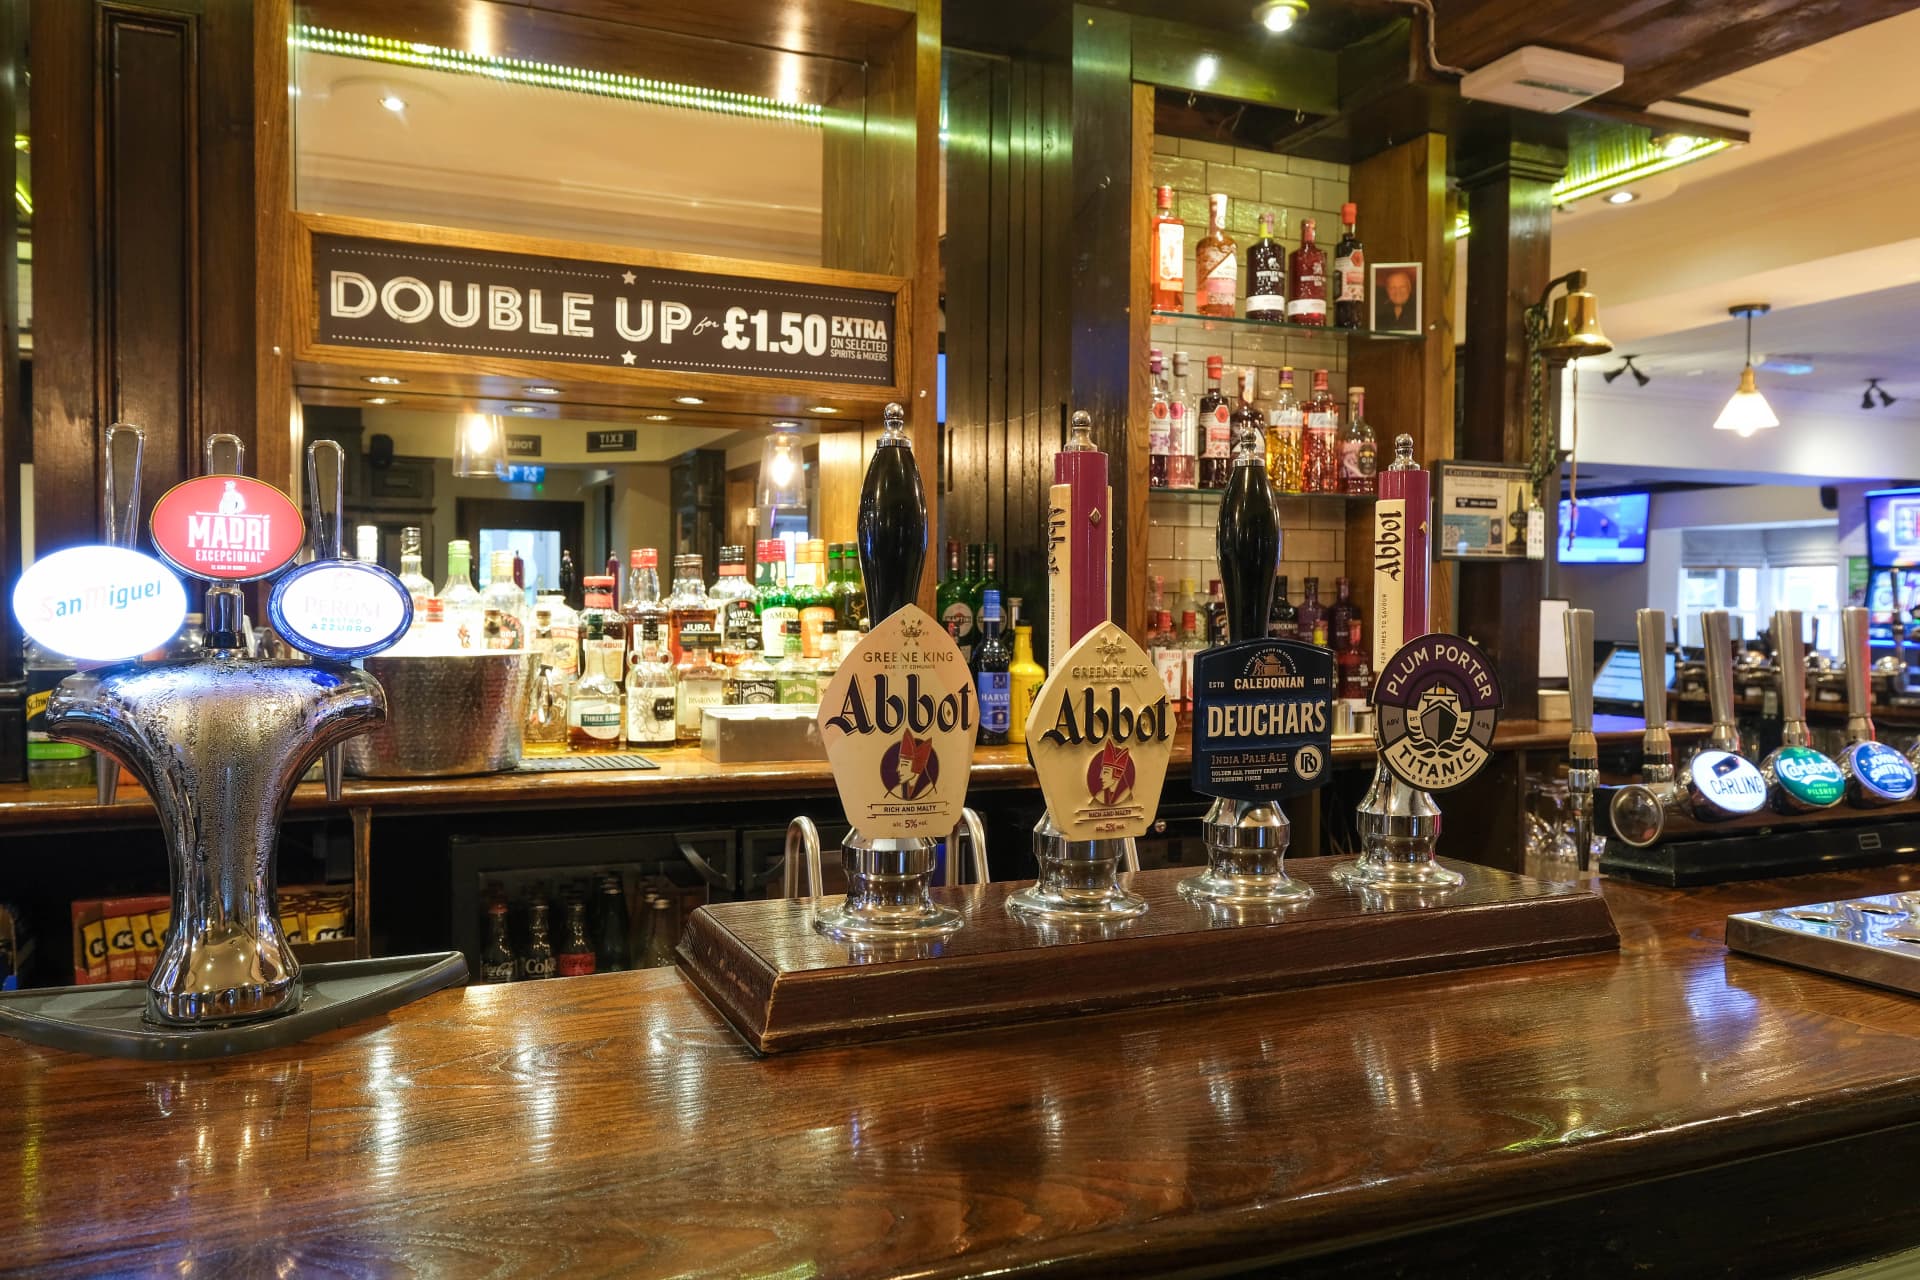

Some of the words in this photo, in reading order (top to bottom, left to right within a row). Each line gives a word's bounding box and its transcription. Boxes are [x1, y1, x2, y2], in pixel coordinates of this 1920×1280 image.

[330, 270, 594, 337] DOUBLE
[615, 297, 692, 344] UP
[693, 315, 719, 336] for
[721, 306, 828, 357] £1.50
[831, 316, 887, 340] EXTRA
[830, 337, 844, 349] ON
[846, 339, 888, 353] SELECTED
[830, 349, 855, 359] SPIRITS
[856, 351, 862, 359] &
[863, 352, 888, 362] MIXERS
[187, 514, 270, 551] MADRÍ
[1375, 511, 1402, 581] Abbot
[195, 550, 262, 563] EXCEPCIONAL
[311, 623, 373, 633] AZZURRO
[683, 623, 711, 632] JURA
[1381, 620, 1388, 628] TO
[863, 651, 918, 663] GREENE
[923, 651, 953, 662] KING
[1072, 666, 1117, 678] GREENE
[1120, 666, 1149, 678] KING
[1386, 647, 1429, 696] PLUM
[1435, 644, 1492, 700] PORTER
[1234, 676, 1305, 690] CALEDONIAN
[825, 673, 972, 736] Abbot
[1037, 686, 1170, 746] Abbot
[1207, 699, 1326, 738] DEUCHARS
[1211, 755, 1239, 765] INDIA
[1242, 753, 1266, 763] PALE
[1268, 752, 1287, 762] ALE
[1399, 744, 1476, 778] TITANIC
[1411, 774, 1459, 785] BREWERY
[1710, 776, 1763, 795] CARLING
[904, 819, 918, 829] 5%
